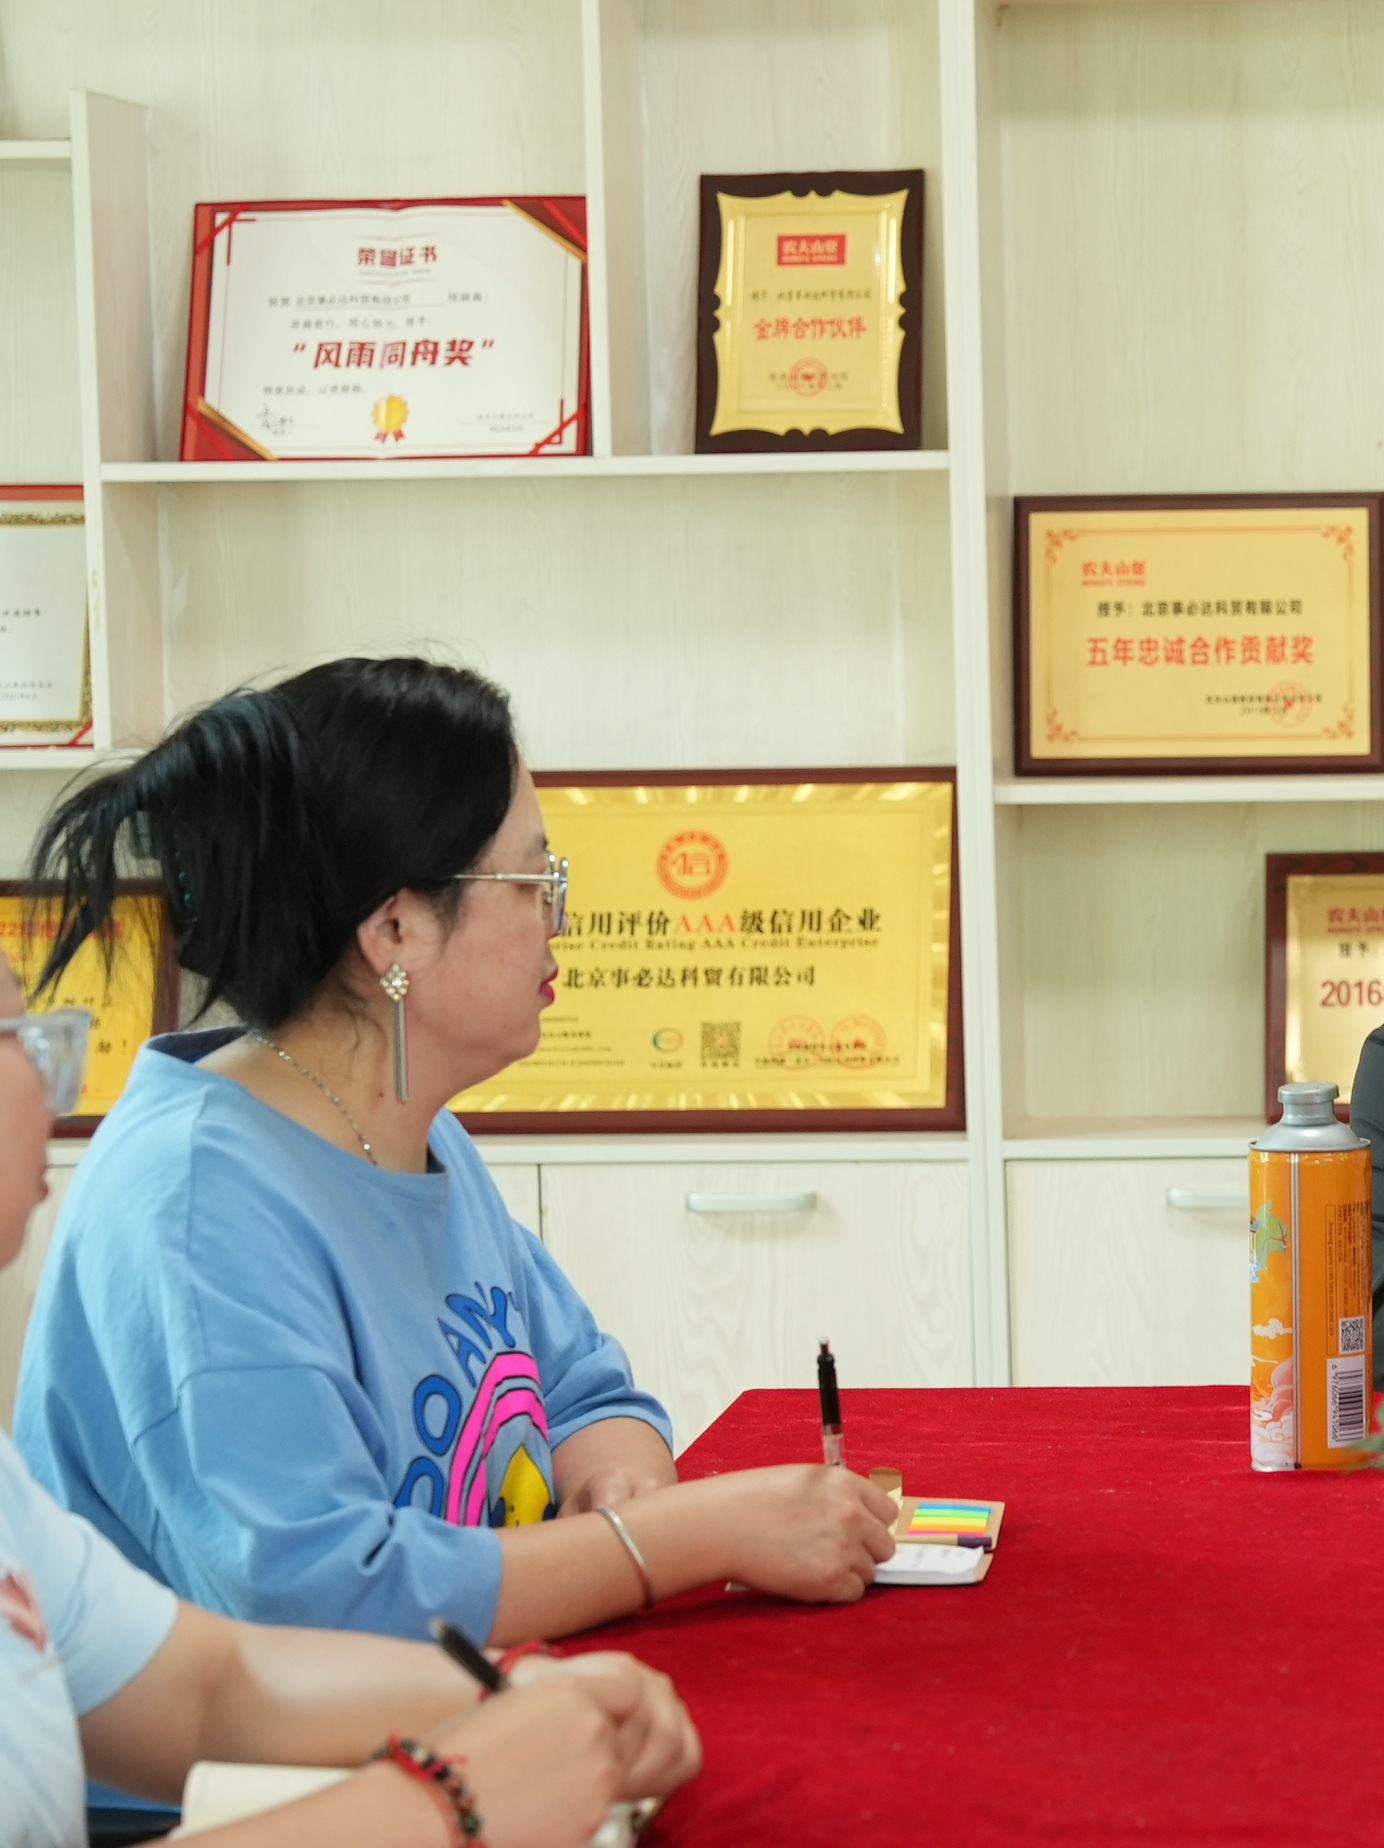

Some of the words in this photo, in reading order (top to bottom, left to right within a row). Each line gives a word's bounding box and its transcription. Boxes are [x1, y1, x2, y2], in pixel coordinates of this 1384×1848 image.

[357, 246, 438, 267] 荣誉证书
[754, 316, 867, 341] 金牌合作伙伴
[1087, 635, 1314, 667] 五年忠诚合作贡献奖
[562, 963, 817, 989] 北京事必达科贸有限公司
